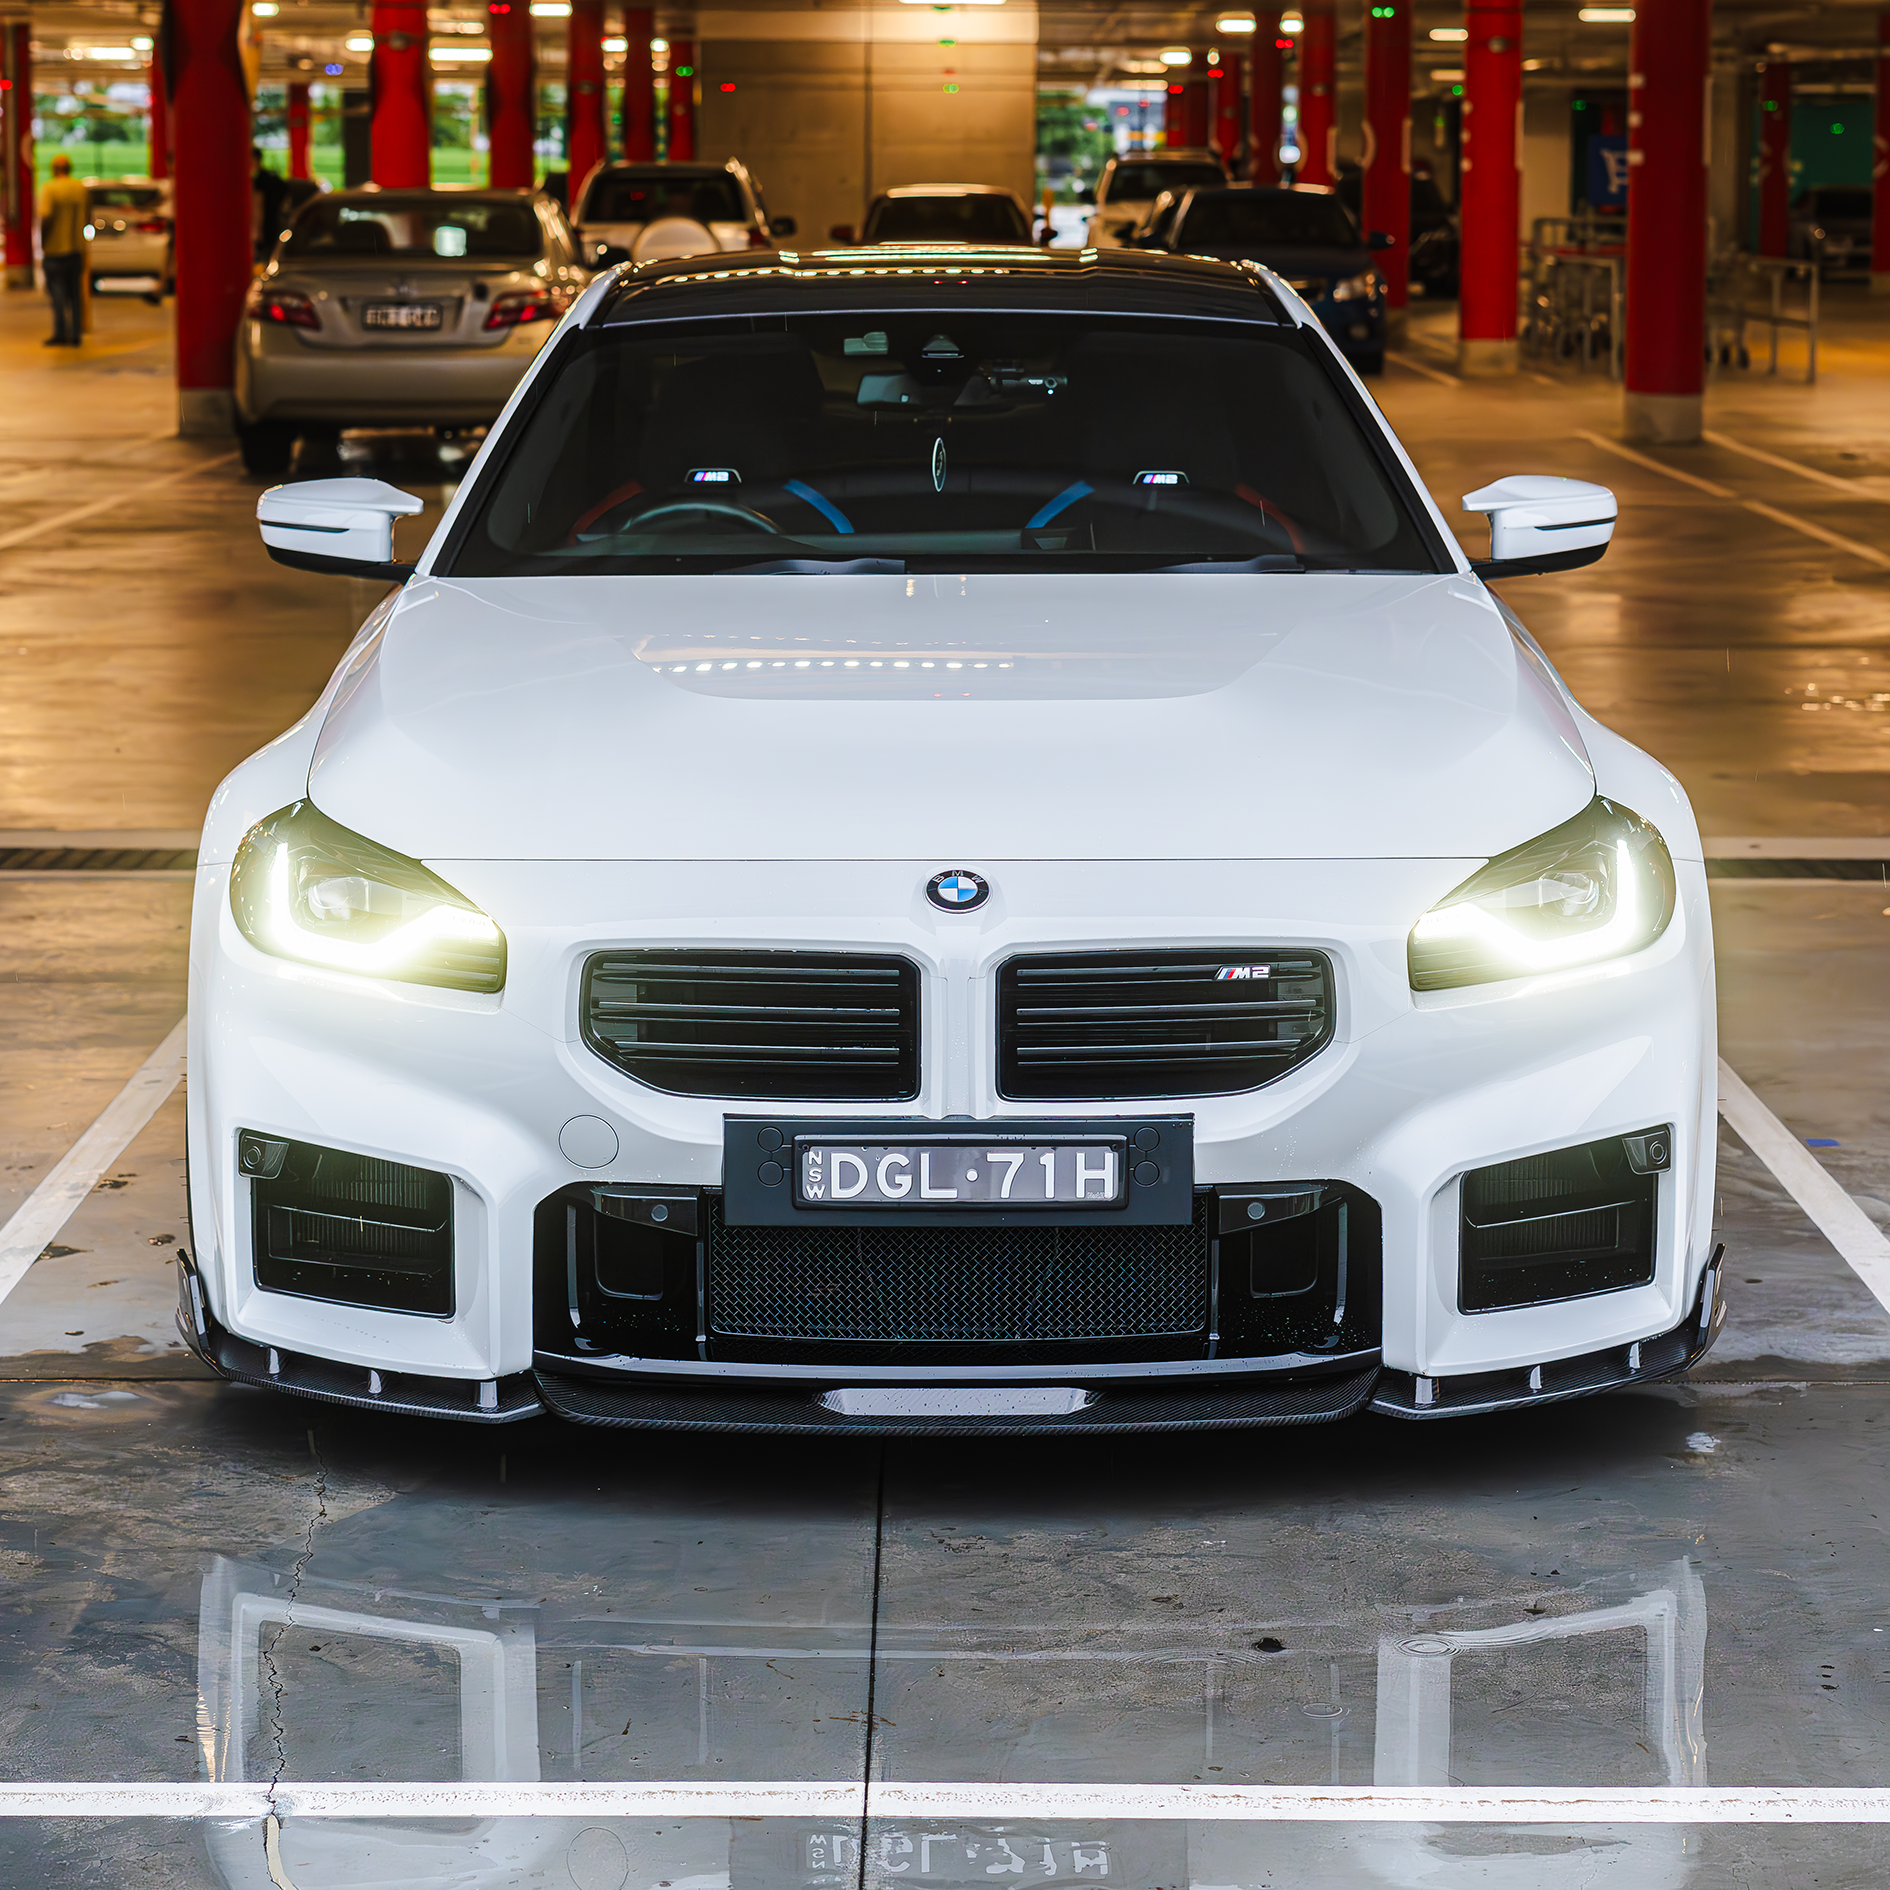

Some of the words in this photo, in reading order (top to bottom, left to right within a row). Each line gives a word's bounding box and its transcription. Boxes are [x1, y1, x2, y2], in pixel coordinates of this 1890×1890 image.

[932, 870, 985, 883] BMW
[1230, 966, 1269, 979] M2
[806, 1151, 826, 1200] NSW
